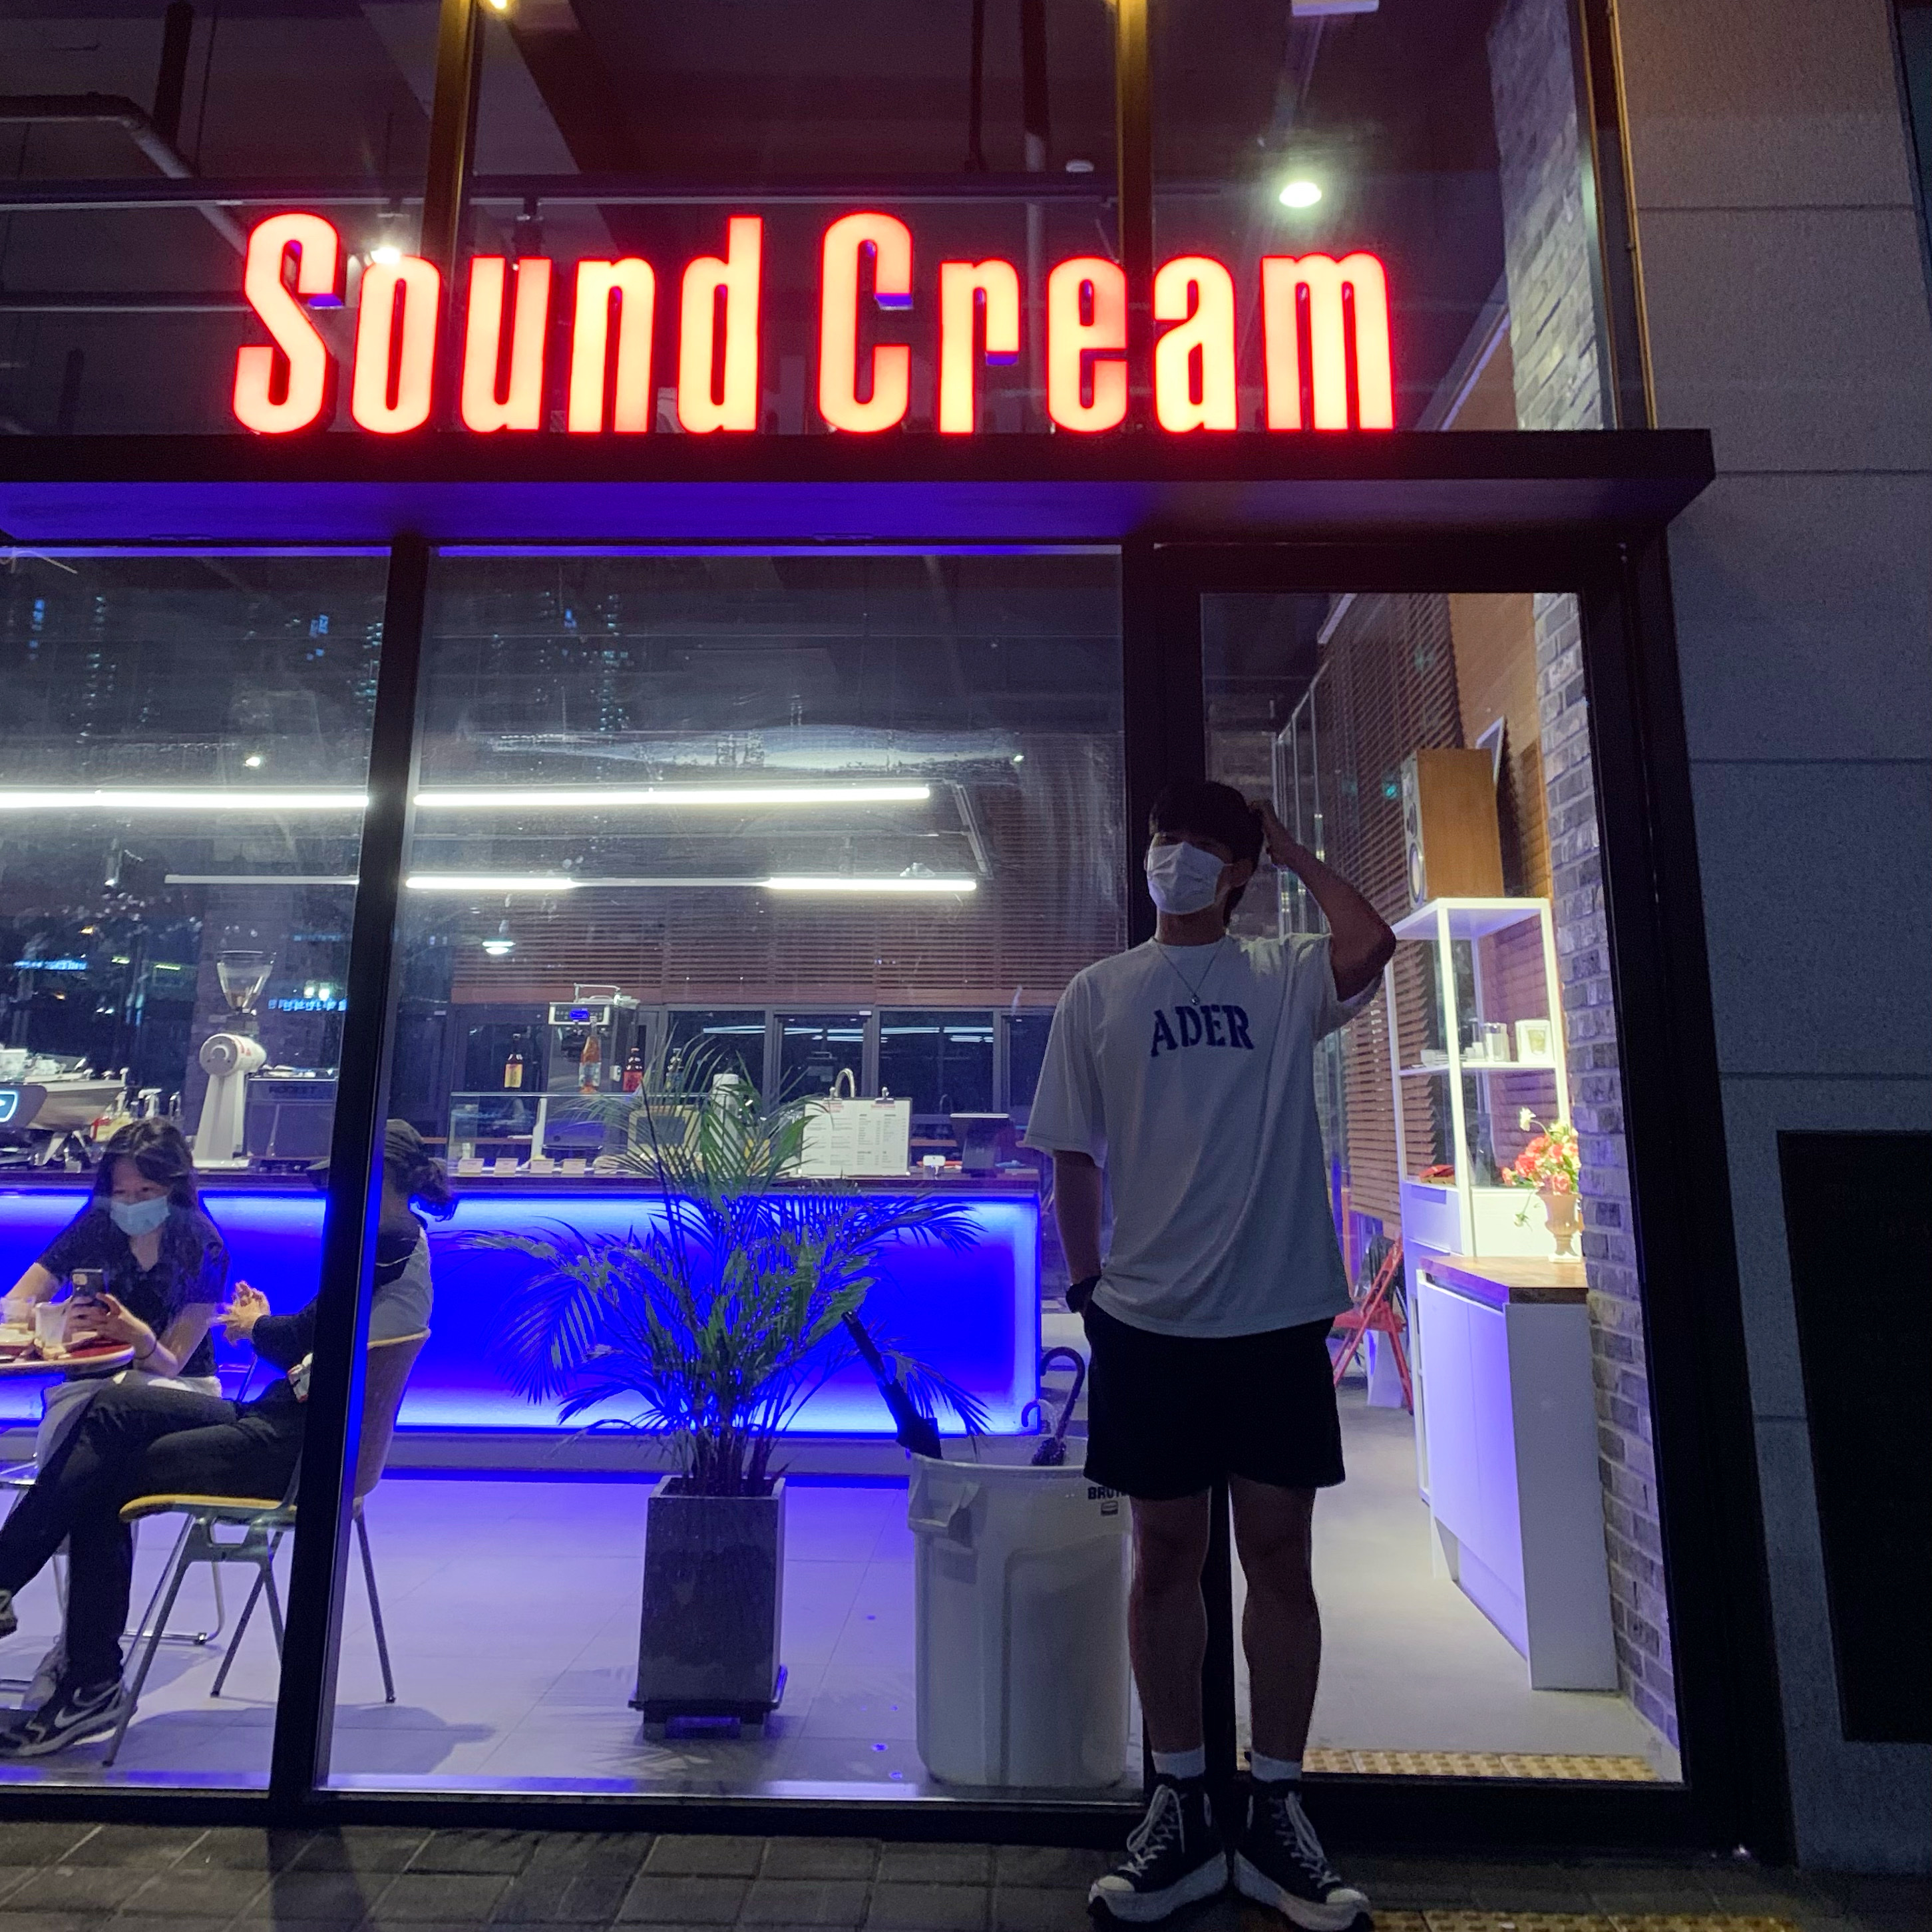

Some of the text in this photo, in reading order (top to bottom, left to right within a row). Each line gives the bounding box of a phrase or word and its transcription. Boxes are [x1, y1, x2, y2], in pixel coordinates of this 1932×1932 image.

[233, 211, 1396, 435] Sound Cream
[1151, 1004, 1255, 1057] ADER
